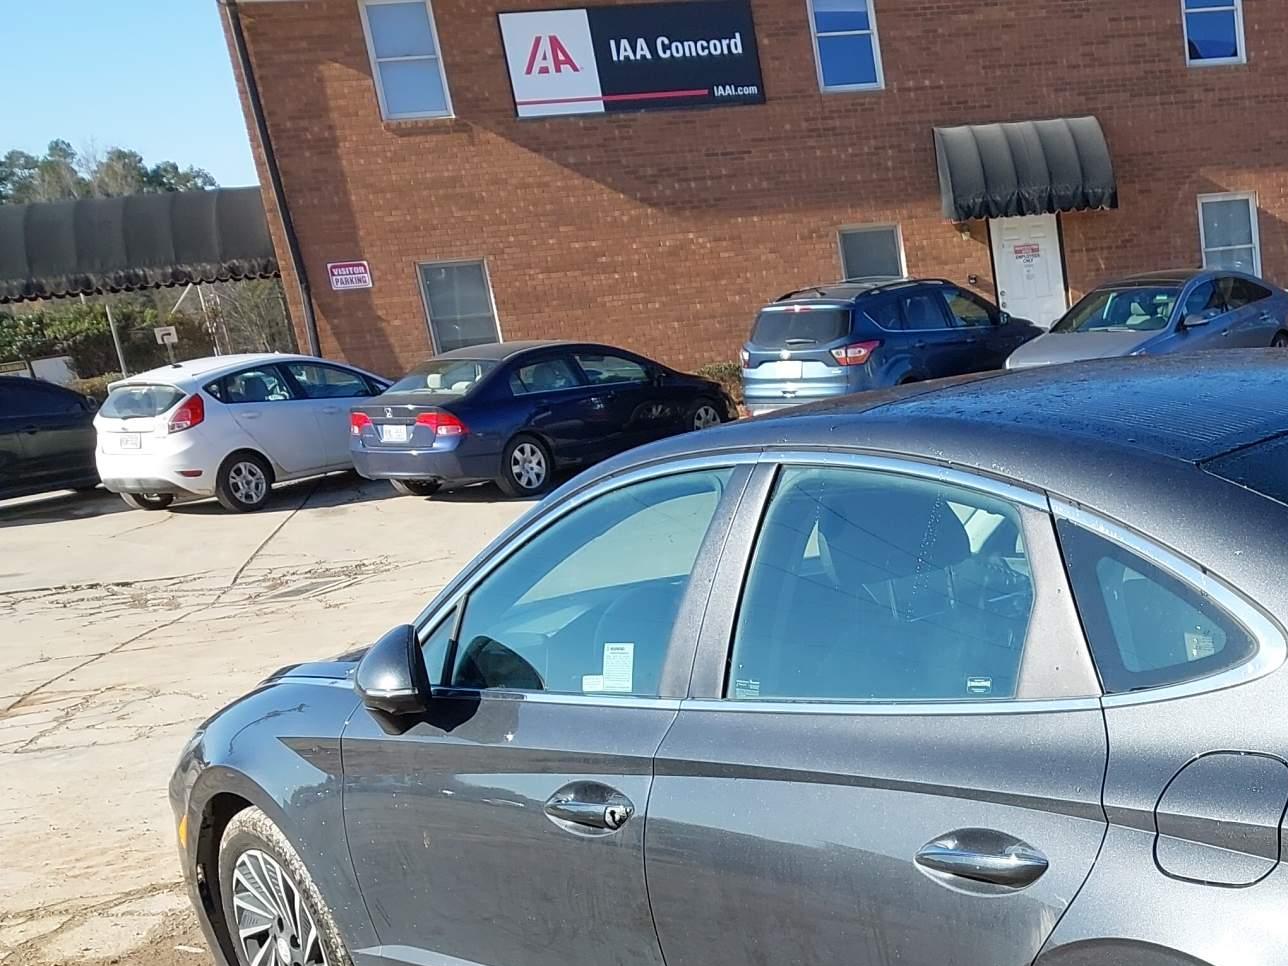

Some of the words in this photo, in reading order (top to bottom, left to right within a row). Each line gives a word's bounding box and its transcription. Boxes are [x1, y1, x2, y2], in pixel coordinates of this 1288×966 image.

[609, 37, 652, 62] IAA
[656, 32, 743, 59] Concord
[713, 84, 758, 97] IAAI.com
[332, 266, 365, 275] VISITOR
[335, 275, 368, 286] PARKING
